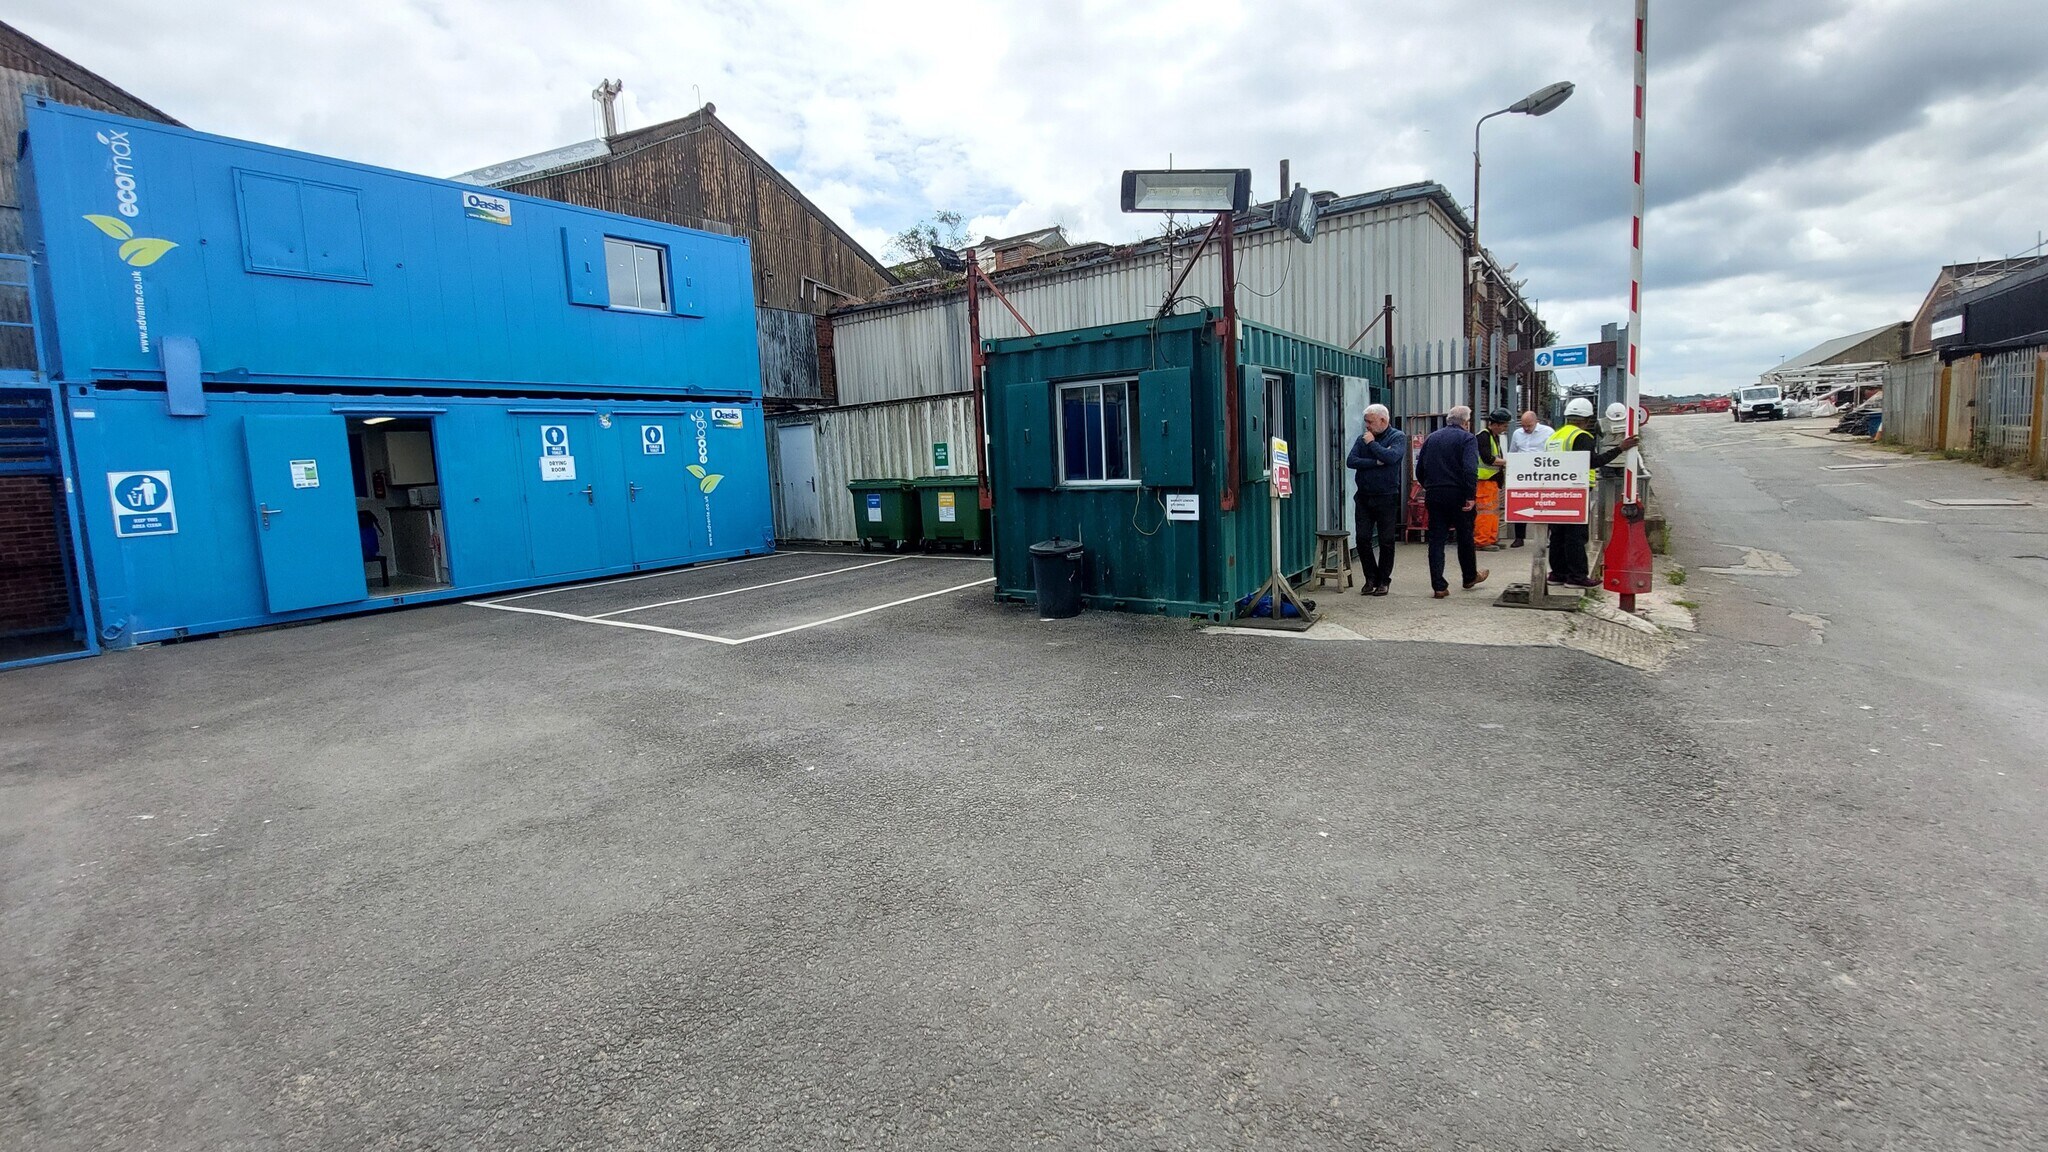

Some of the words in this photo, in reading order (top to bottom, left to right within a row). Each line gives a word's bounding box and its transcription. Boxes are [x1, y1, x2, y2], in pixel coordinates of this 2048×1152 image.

[109, 129, 140, 218] ecomax
[468, 195, 505, 212] Oasis
[714, 409, 739, 420] Oasis
[695, 409, 708, 464] ecologic
[1533, 457, 1561, 468] Site
[1516, 471, 1578, 482] entrance
[1541, 491, 1582, 500] pedestrian
